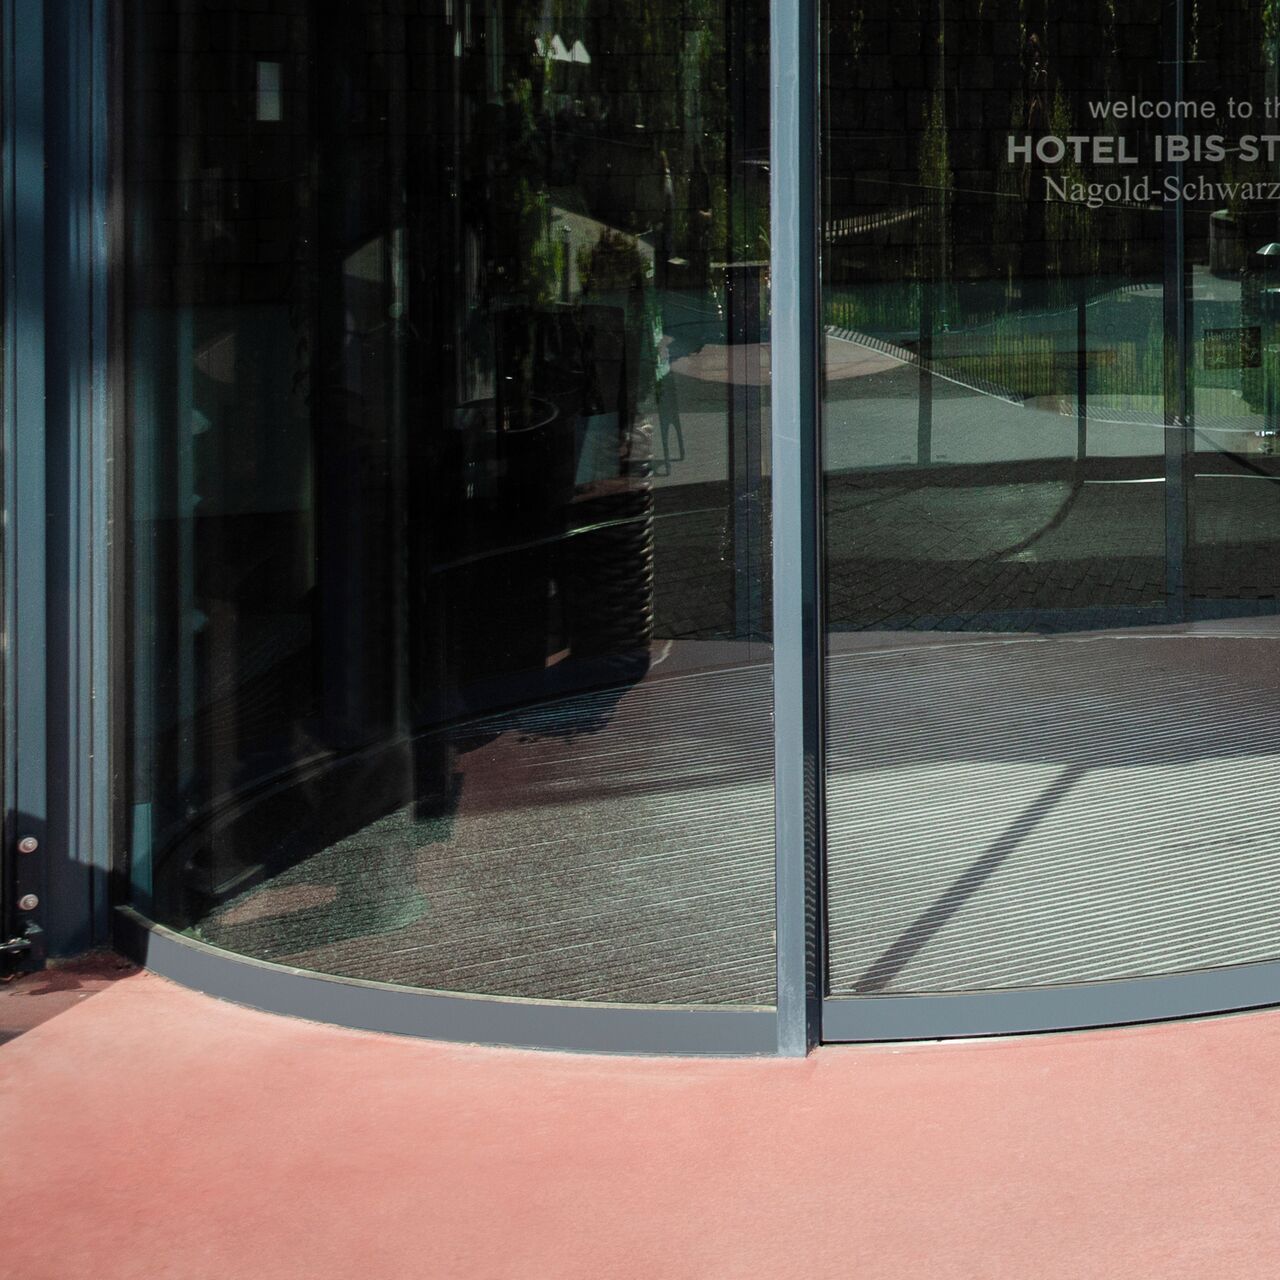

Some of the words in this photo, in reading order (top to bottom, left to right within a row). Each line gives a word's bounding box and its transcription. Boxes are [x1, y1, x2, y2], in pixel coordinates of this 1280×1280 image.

[1088, 96, 1216, 119] welcome
[1228, 96, 1253, 119] to
[1007, 135, 1139, 164] HOTEL
[1155, 135, 1227, 163] IBIS
